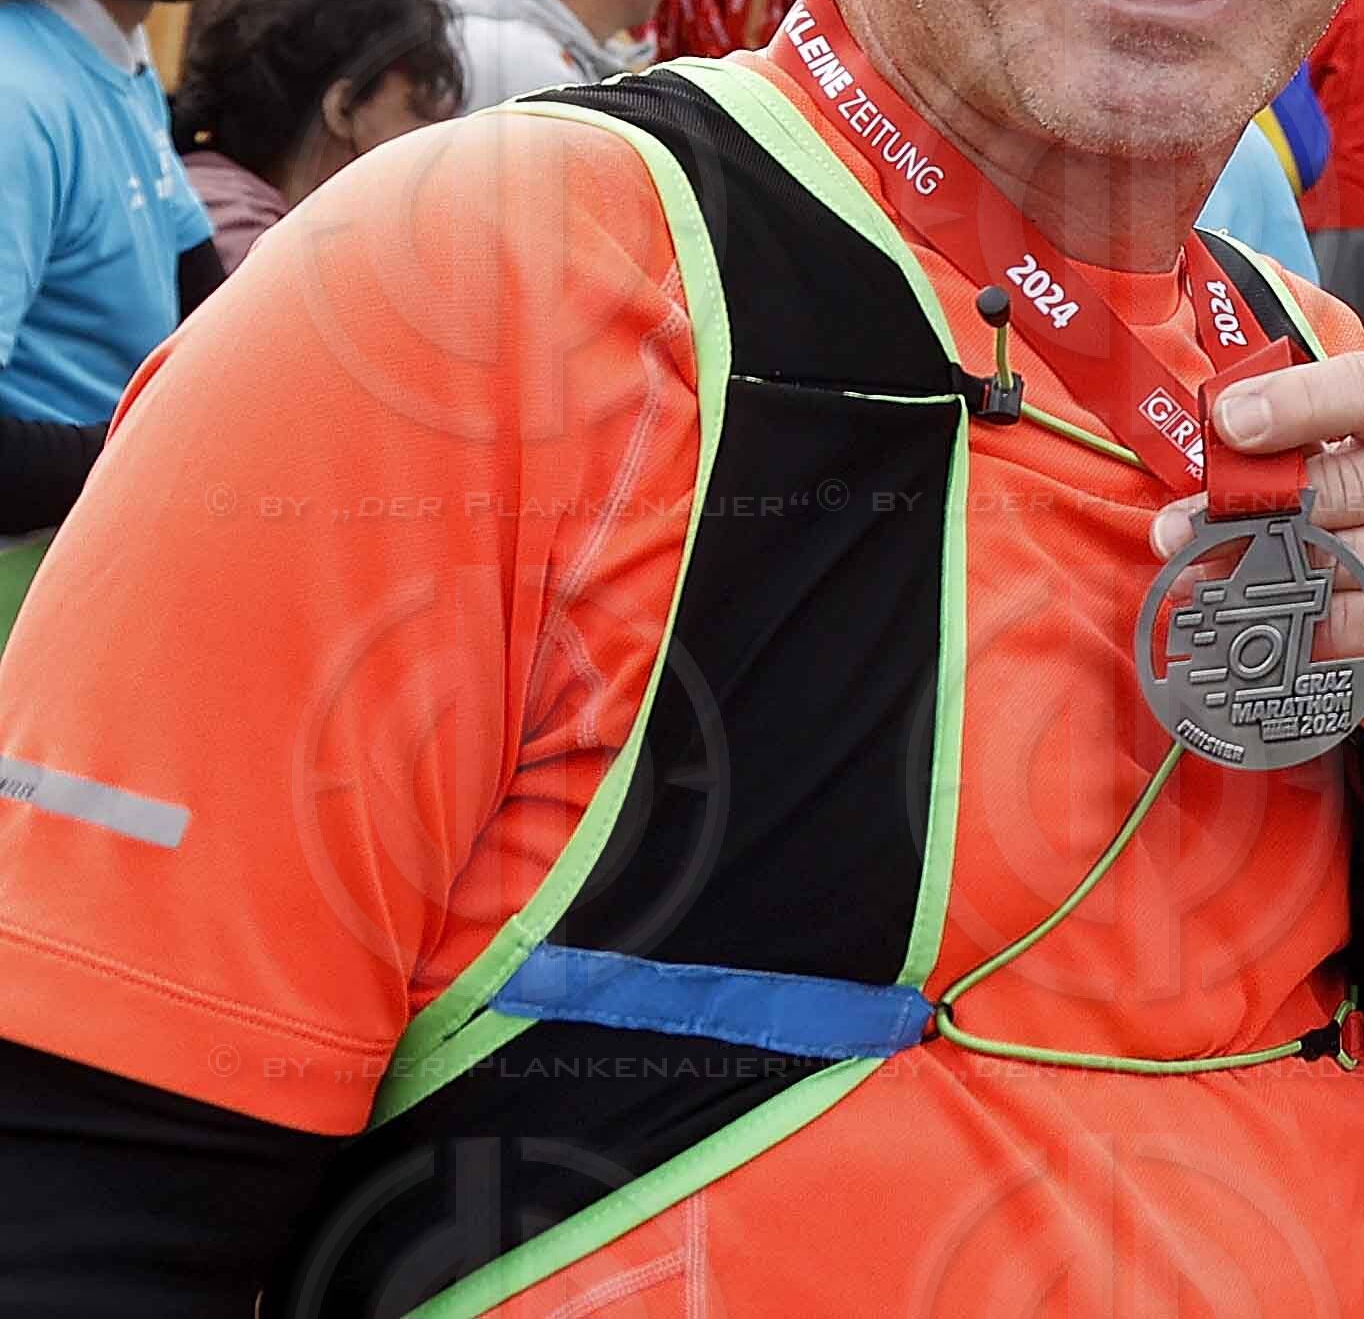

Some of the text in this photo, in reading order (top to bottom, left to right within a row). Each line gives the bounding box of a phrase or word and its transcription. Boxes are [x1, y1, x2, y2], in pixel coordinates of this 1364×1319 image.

[781, 3, 1081, 329] KLEINE ZEITUNG 2024
[1205, 279, 1248, 348] 2024
[1295, 670, 1353, 695] GRAZ
[1231, 690, 1353, 724] MARATHON
[1300, 712, 1351, 736] 2024
[1176, 718, 1245, 762] FINISHER
